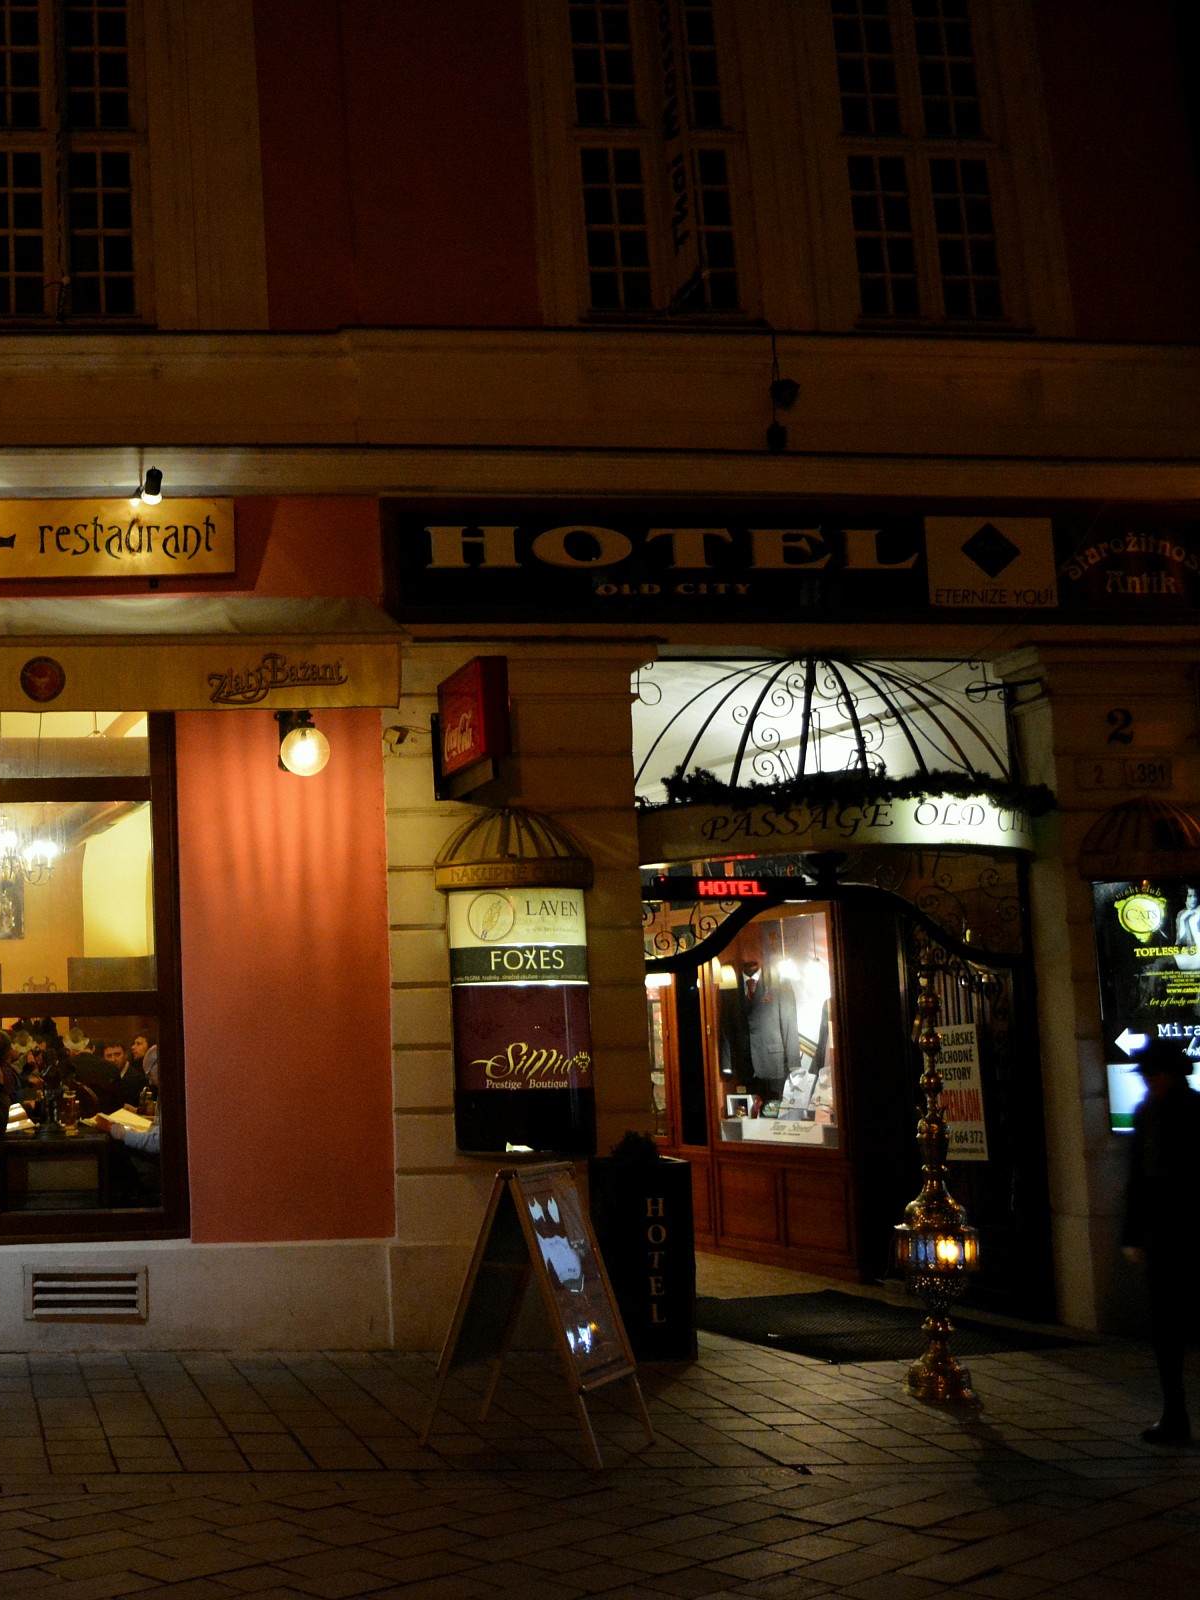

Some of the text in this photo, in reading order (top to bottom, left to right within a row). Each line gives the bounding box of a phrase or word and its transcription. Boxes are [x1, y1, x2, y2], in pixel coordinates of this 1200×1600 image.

[38, 515, 216, 560] restaurant
[423, 525, 921, 570] HOTEL
[1061, 531, 1200, 581] Starožitnos
[595, 582, 753, 596] OLD CITY
[1105, 570, 1177, 594] Antik
[935, 588, 1007, 605] ETERNIZE
[1106, 708, 1134, 744] 2
[701, 802, 1031, 843] PASSAGE OLD CIT
[698, 880, 768, 896] HOTEL
[526, 900, 578, 917] LAVEN
[1126, 908, 1158, 921] CATS
[490, 946, 565, 971] FOXES
[1133, 946, 1179, 957] TOPLESS
[942, 1030, 975, 1046] ELÁRSKE
[486, 1079, 569, 1090] Prestige Boutique
[645, 1197, 667, 1324] HOTEL
